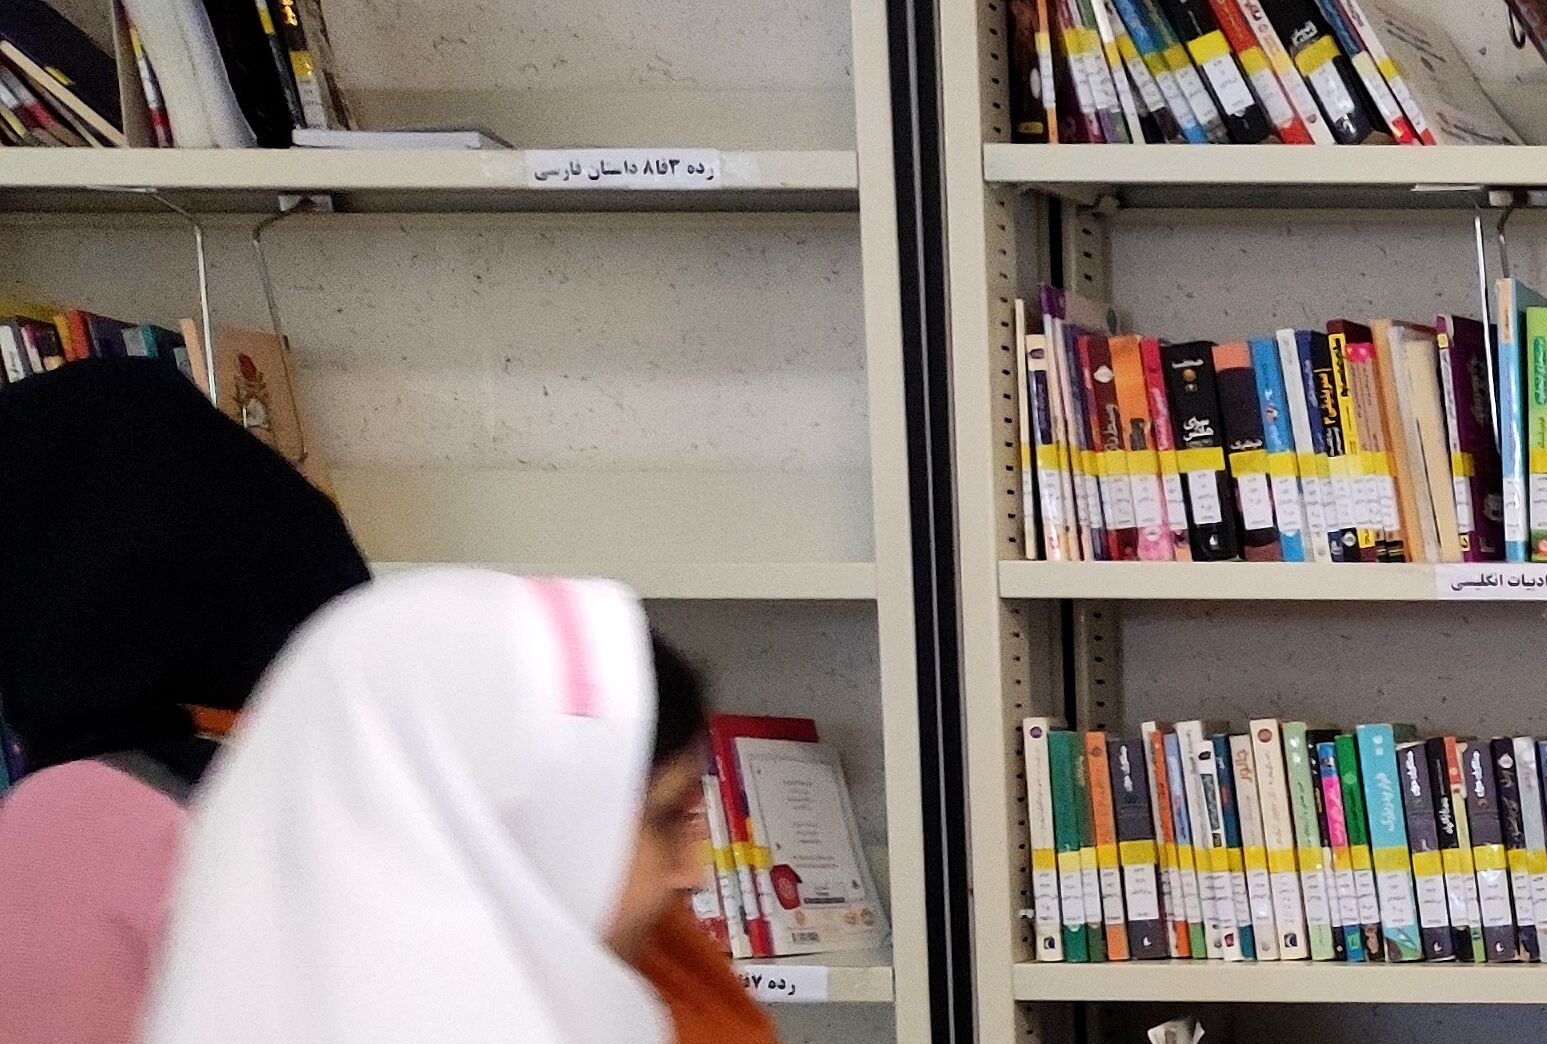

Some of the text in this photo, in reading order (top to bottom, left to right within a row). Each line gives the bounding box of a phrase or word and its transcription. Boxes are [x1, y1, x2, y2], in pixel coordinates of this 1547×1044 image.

[534, 160, 582, 181] فارسی
[588, 159, 638, 181] داستان
[687, 162, 714, 181] رده
[1451, 573, 1503, 592] انگلیسی
[767, 977, 796, 996] رده
